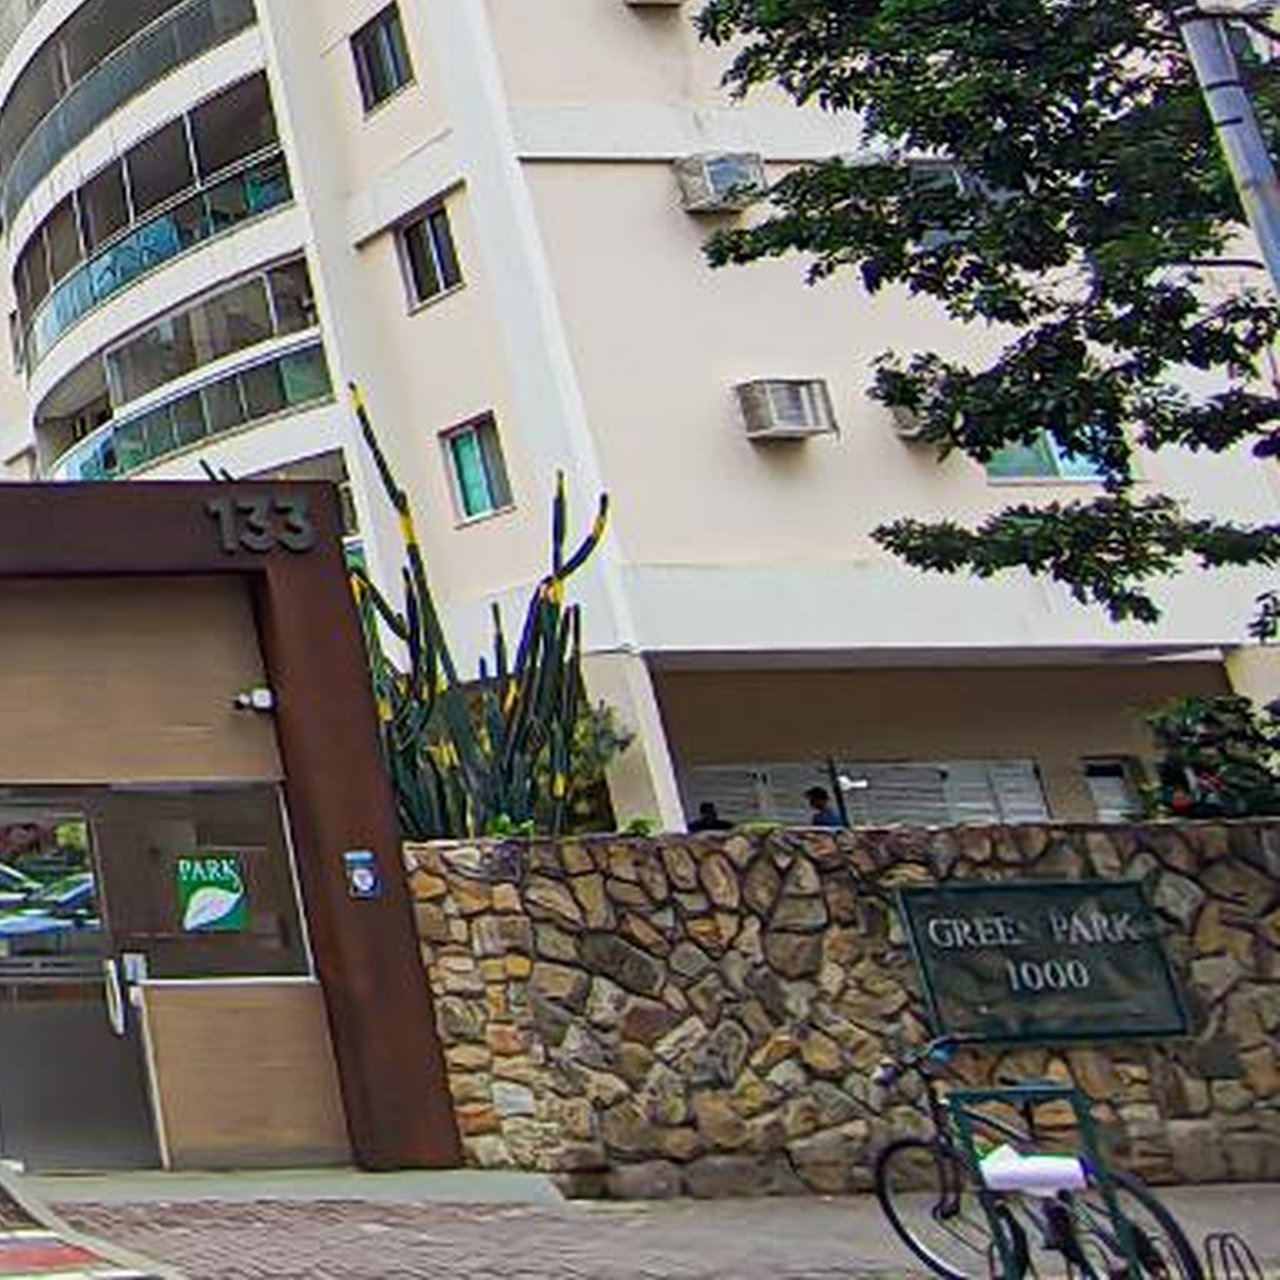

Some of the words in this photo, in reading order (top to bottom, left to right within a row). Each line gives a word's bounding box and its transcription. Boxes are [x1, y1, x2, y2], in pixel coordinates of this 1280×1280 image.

[206, 493, 316, 555] 133
[178, 858, 240, 882] PARK
[1049, 910, 1140, 946] PARK
[1006, 958, 1090, 991] 1000
